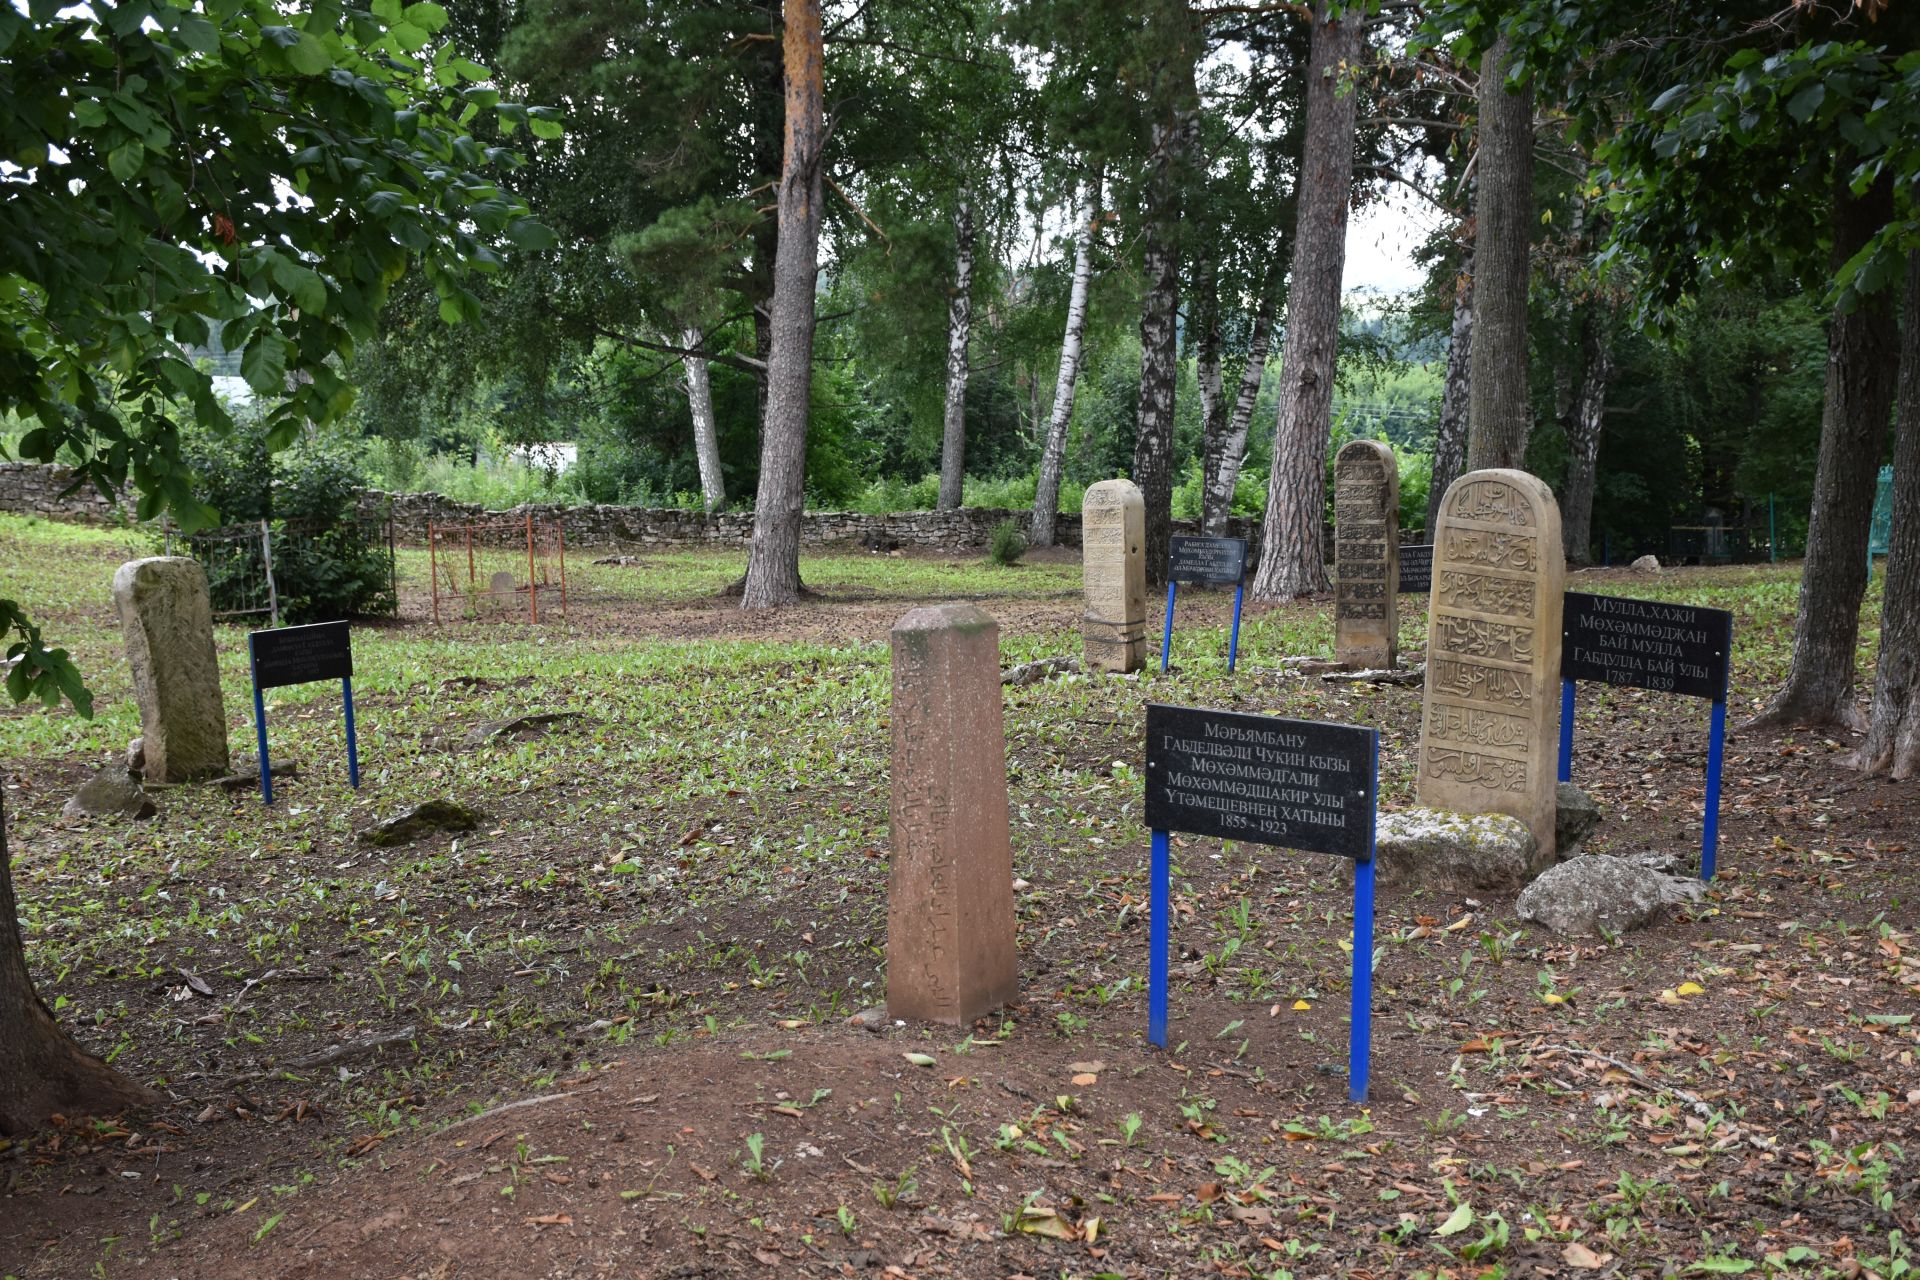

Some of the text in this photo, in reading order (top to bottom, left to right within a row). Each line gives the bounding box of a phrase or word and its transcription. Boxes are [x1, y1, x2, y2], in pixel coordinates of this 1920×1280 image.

[1599, 634, 1683, 657] БАЙ МУЛЛА
[1573, 647, 1709, 679] ГАБДУЛЛА БАЙ УЛЫ
[1605, 669, 1632, 684] 1787
[1646, 675, 1674, 690] 1839
[1256, 747, 1304, 766] ЧУКИН
[1309, 755, 1351, 772] КЫЗЫ
[1313, 792, 1344, 808] УЛЫ
[1219, 814, 1247, 829] 1855
[1259, 819, 1288, 835] 1923
[1281, 806, 1345, 827] ХАТЫНЫ
